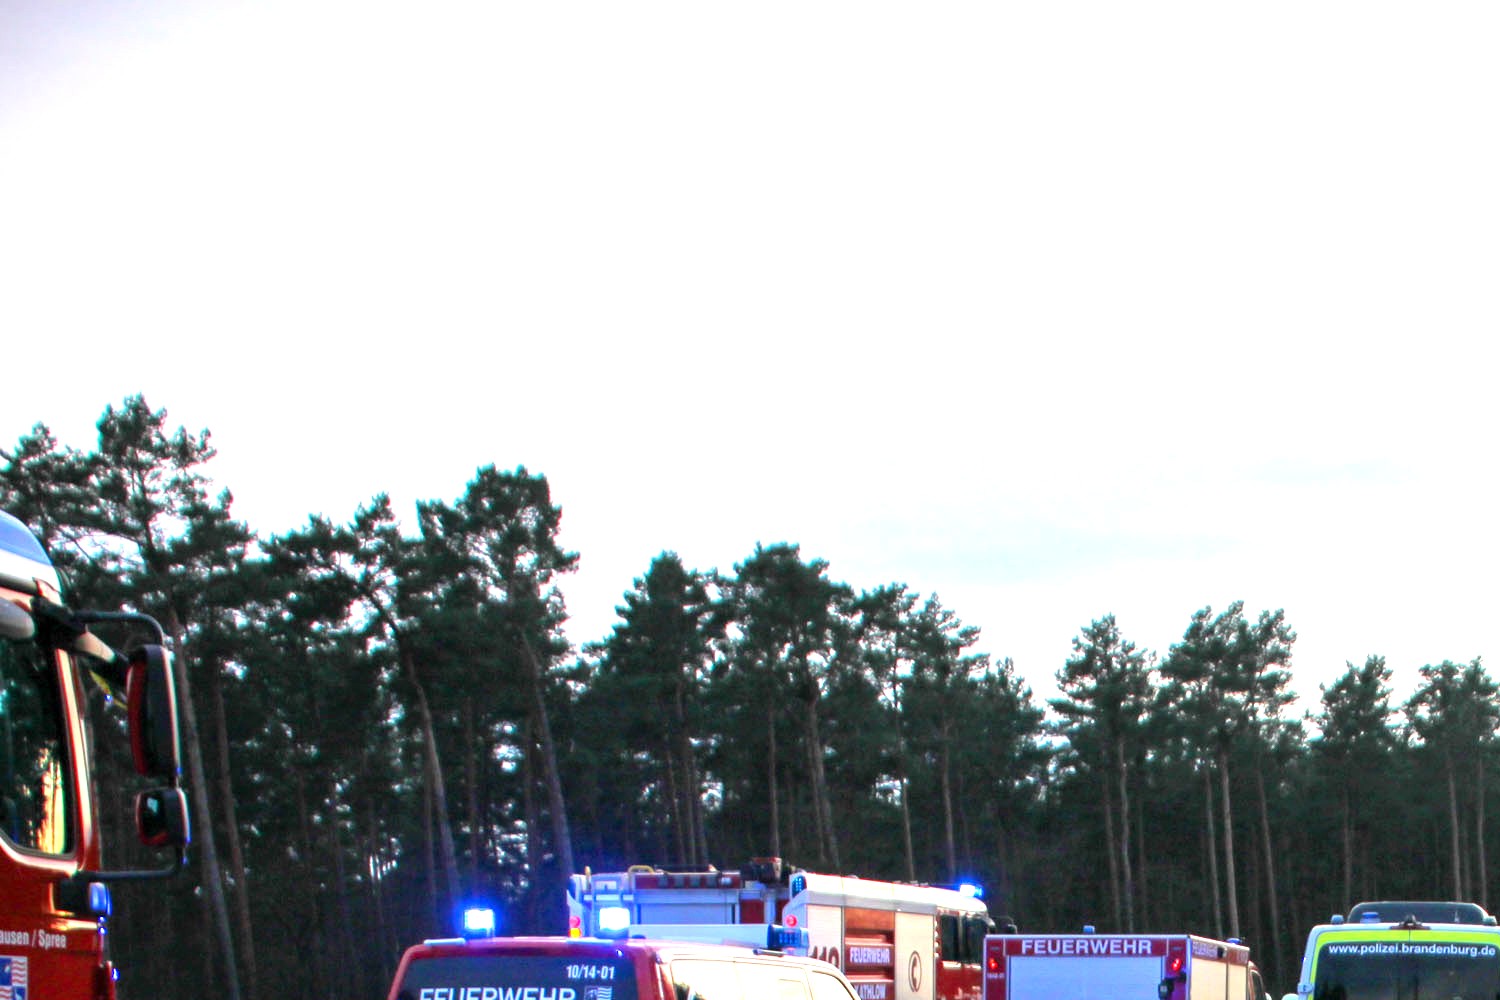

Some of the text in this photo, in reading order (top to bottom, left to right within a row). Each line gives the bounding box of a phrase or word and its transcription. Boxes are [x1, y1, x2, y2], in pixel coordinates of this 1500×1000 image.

[38, 929, 67, 950] Spree
[1021, 939, 1152, 955] FEUERWEHR
[850, 946, 890, 964] FEUERWEHR
[1328, 943, 1496, 957] www.polizei.brandenburg.de
